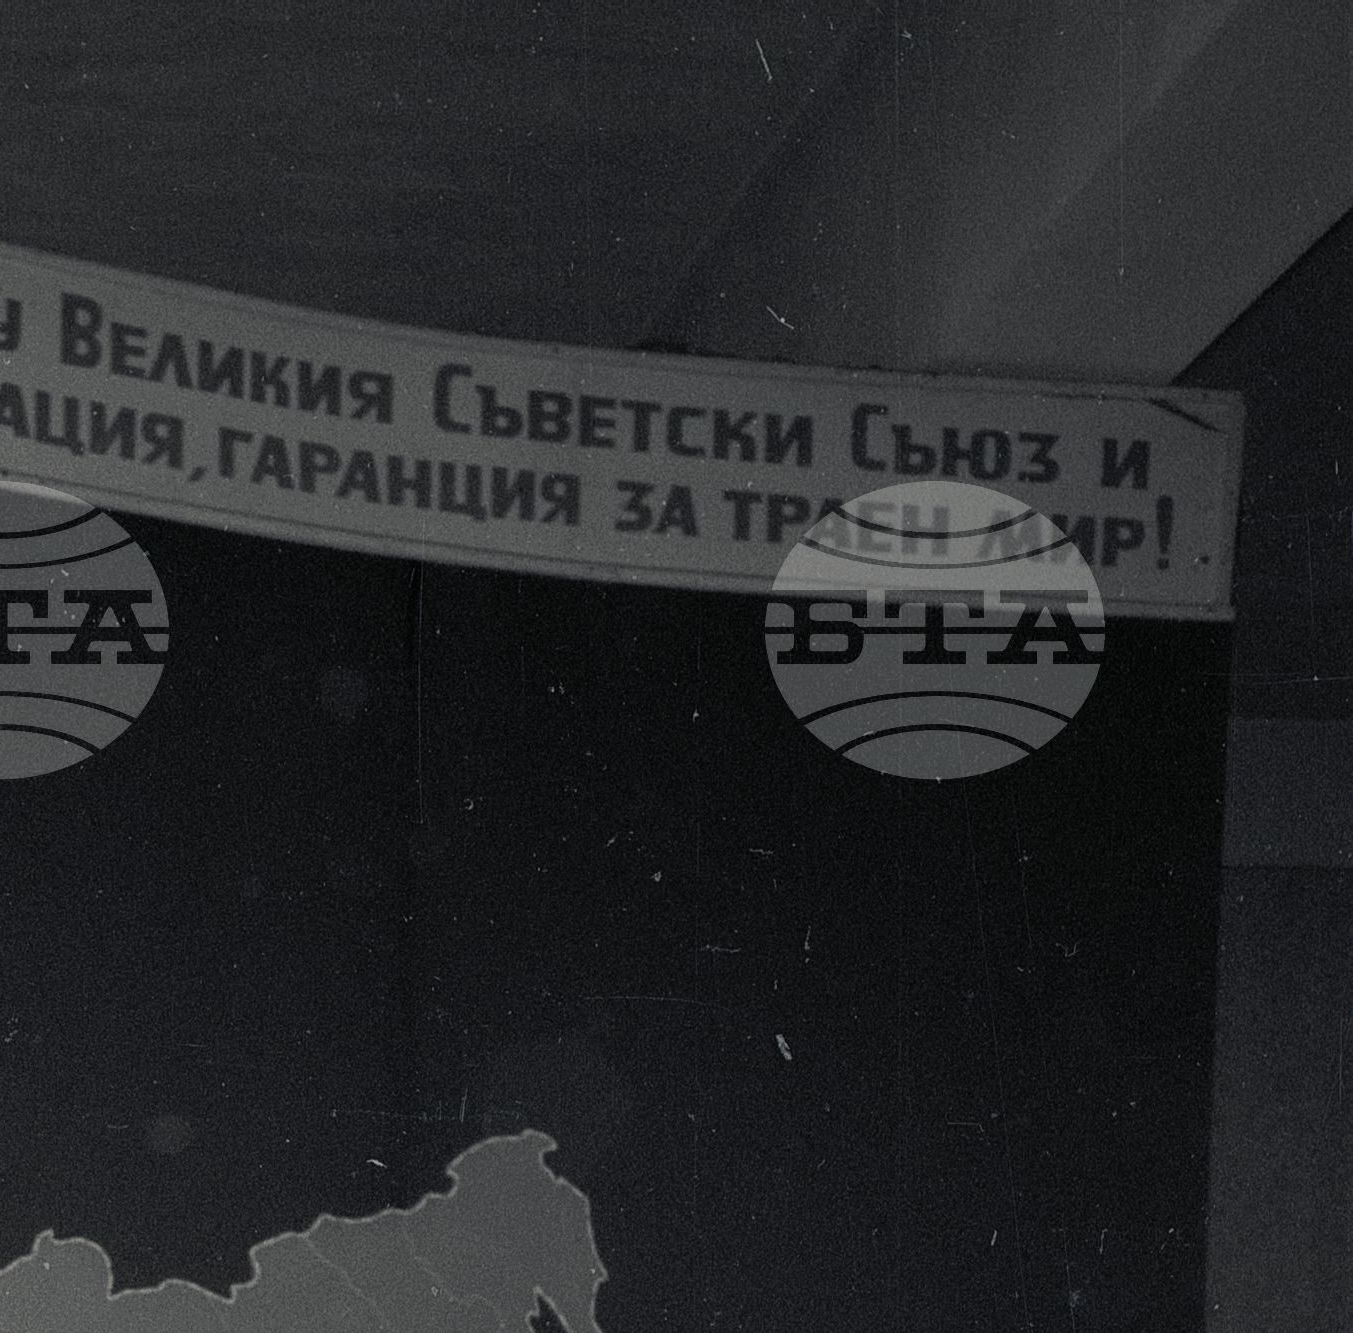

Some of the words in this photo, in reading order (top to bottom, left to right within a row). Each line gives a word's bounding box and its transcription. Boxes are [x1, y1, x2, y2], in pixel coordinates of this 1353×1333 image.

[1100, 437, 1152, 490] И
[613, 479, 702, 540] ЗА
[723, 488, 950, 561] ТРАЕН
[975, 496, 1176, 571] МИР!
